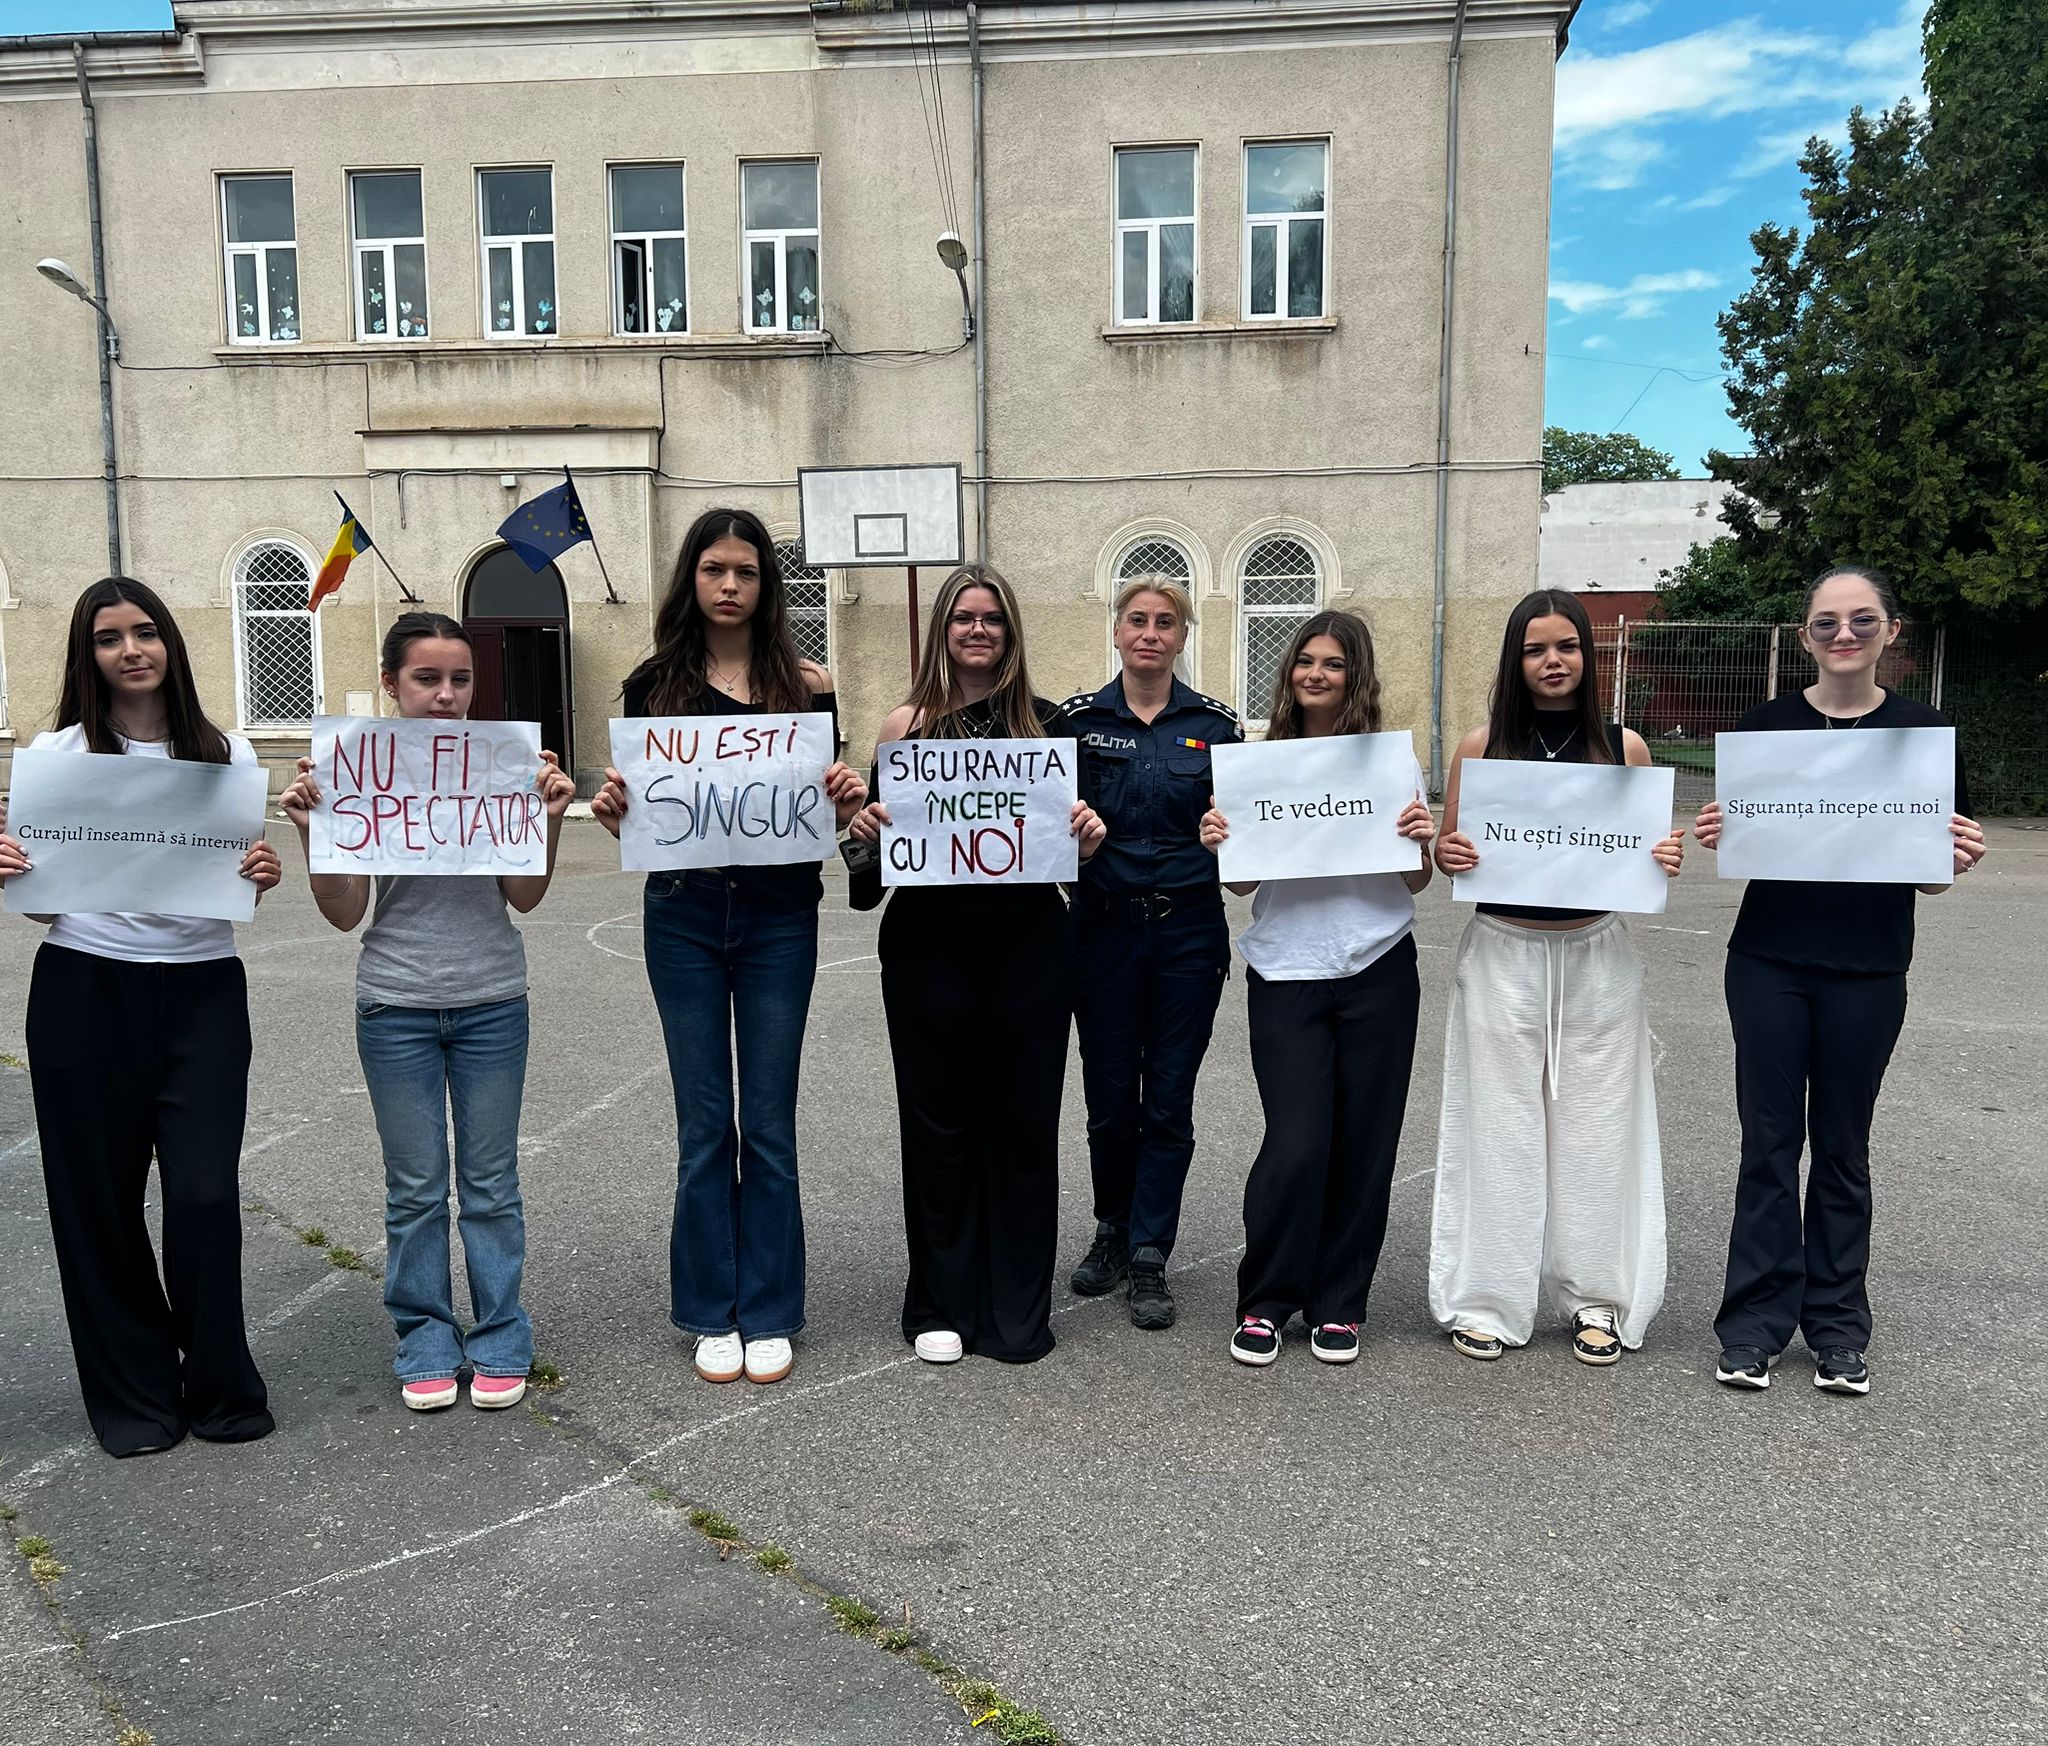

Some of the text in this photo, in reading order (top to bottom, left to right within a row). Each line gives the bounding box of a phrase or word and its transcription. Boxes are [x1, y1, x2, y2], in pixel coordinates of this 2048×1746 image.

[333, 731, 396, 793] NU
[645, 727, 699, 764] NU
[331, 791, 544, 851] SPECTATOR
[925, 790, 1027, 825] ÎNCEPE
[1254, 793, 1374, 822] Te vedem
[1728, 798, 1940, 820] Siguranța începe cu noi
[18, 824, 250, 851] Curajul înseamnă să intervii
[889, 836, 927, 873] CU
[1484, 822, 1642, 853] Nu ești singur
